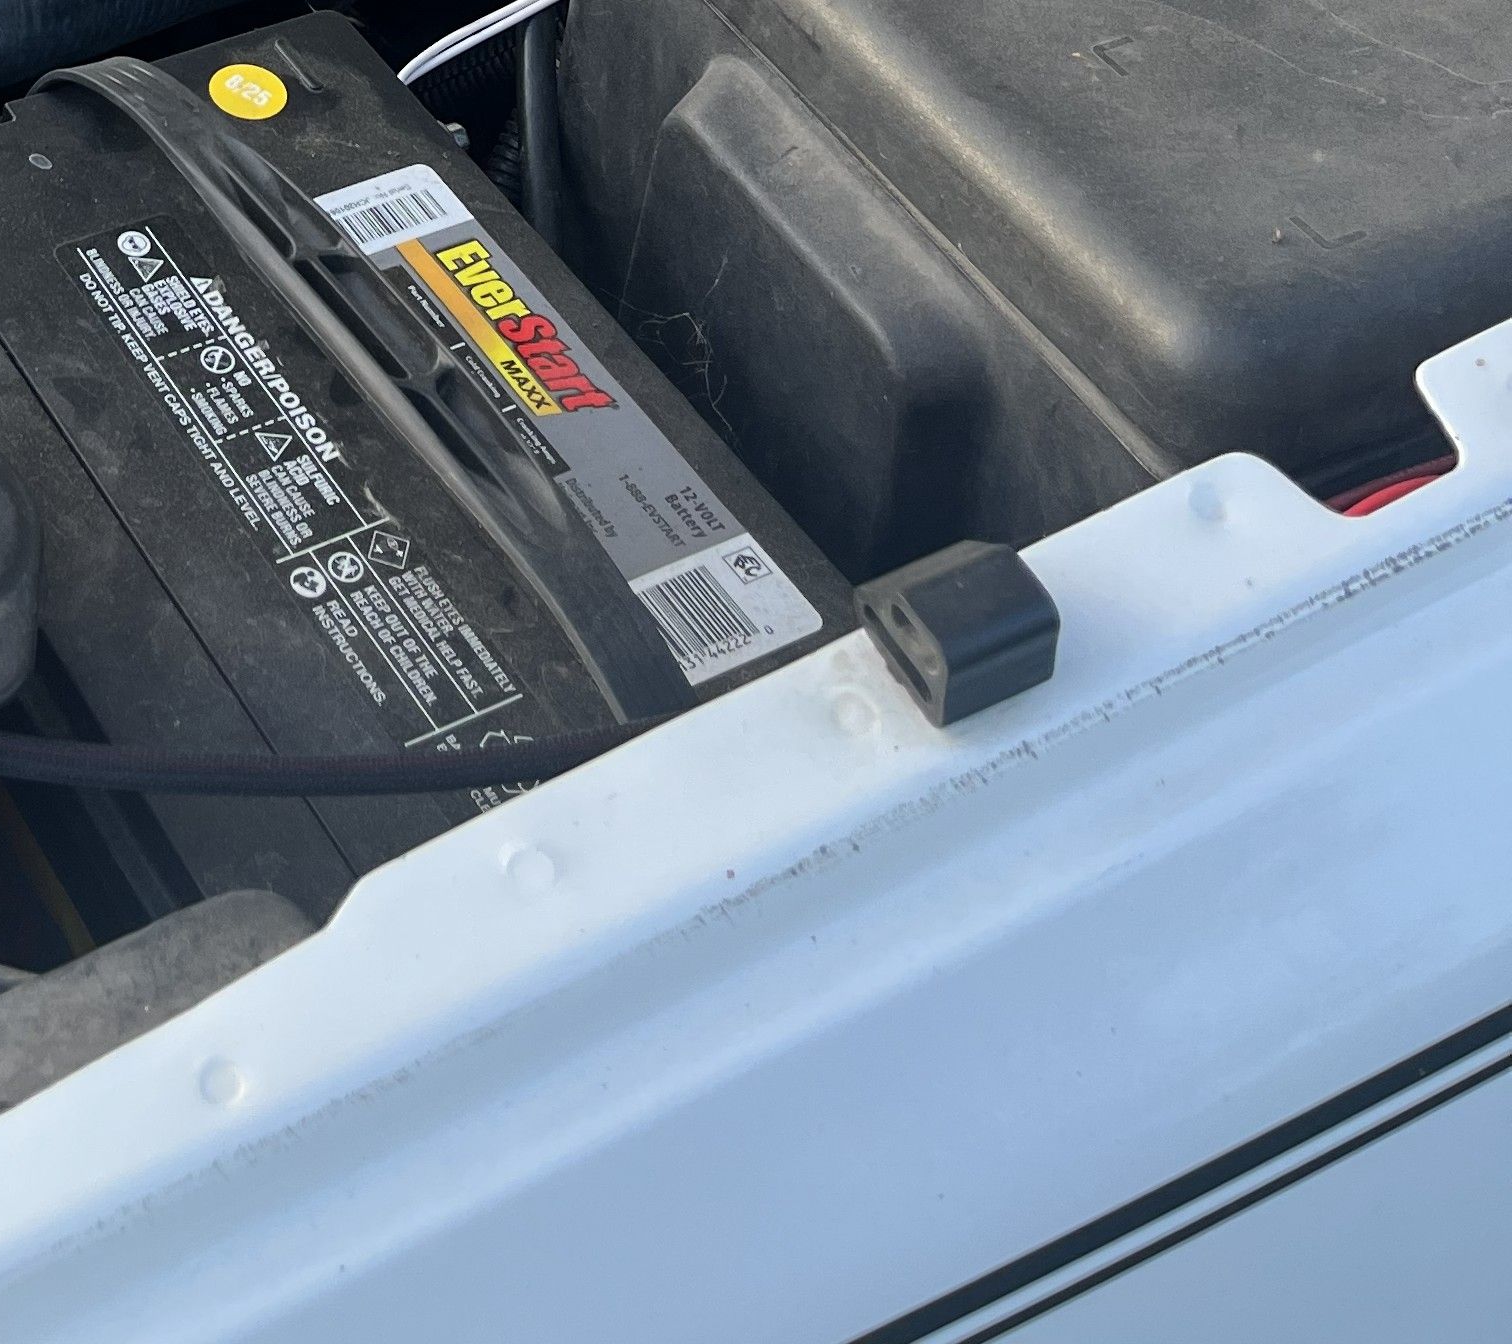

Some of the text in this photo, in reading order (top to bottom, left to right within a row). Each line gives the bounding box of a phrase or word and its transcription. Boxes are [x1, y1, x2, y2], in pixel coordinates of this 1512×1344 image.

[85, 247, 125, 295] BLINDNESS
[117, 293, 135, 309] OR
[140, 283, 171, 316] GASES
[165, 275, 197, 308] SHIELD
[128, 287, 169, 335] CAN CAUSE
[152, 280, 197, 331] EXPLOSIVE
[435, 239, 618, 412] EverStart
[202, 288, 340, 462] DANGER/POISON
[232, 369, 252, 388] NO
[499, 358, 551, 410] MAXX
[78, 273, 97, 290] DO
[90, 290, 114, 312] NOT
[120, 333, 149, 362] KEEP
[143, 362, 170, 393] VENT
[162, 393, 192, 426] CAPS
[185, 425, 217, 460] TIGHT
[209, 461, 235, 488] AND
[228, 488, 261, 531] LEVEL.
[244, 474, 278, 512] SEVERE
[269, 464, 315, 517] CAN CAUSE
[281, 459, 310, 486] ACID
[295, 454, 341, 506] SULFURIC
[257, 468, 313, 538] BLINDNESS OR
[618, 474, 685, 548] 1-888-EVSTART
[664, 493, 707, 540] Battery
[679, 486, 725, 532] 12-VOLT
[400, 570, 428, 599] WITH
[325, 600, 359, 637] READ
[362, 585, 438, 679] KEEP OUT OF THE
[387, 576, 483, 700] GET MEDICAL HELP FAST.
[412, 565, 516, 693] FLUSH EYES IMMEDIATELY
[708, 634, 753, 660] 44222
[764, 624, 775, 635] 0
[311, 605, 387, 707] INSTRUCTIONS.
[348, 590, 437, 707] REACH OF CHILDREN.
